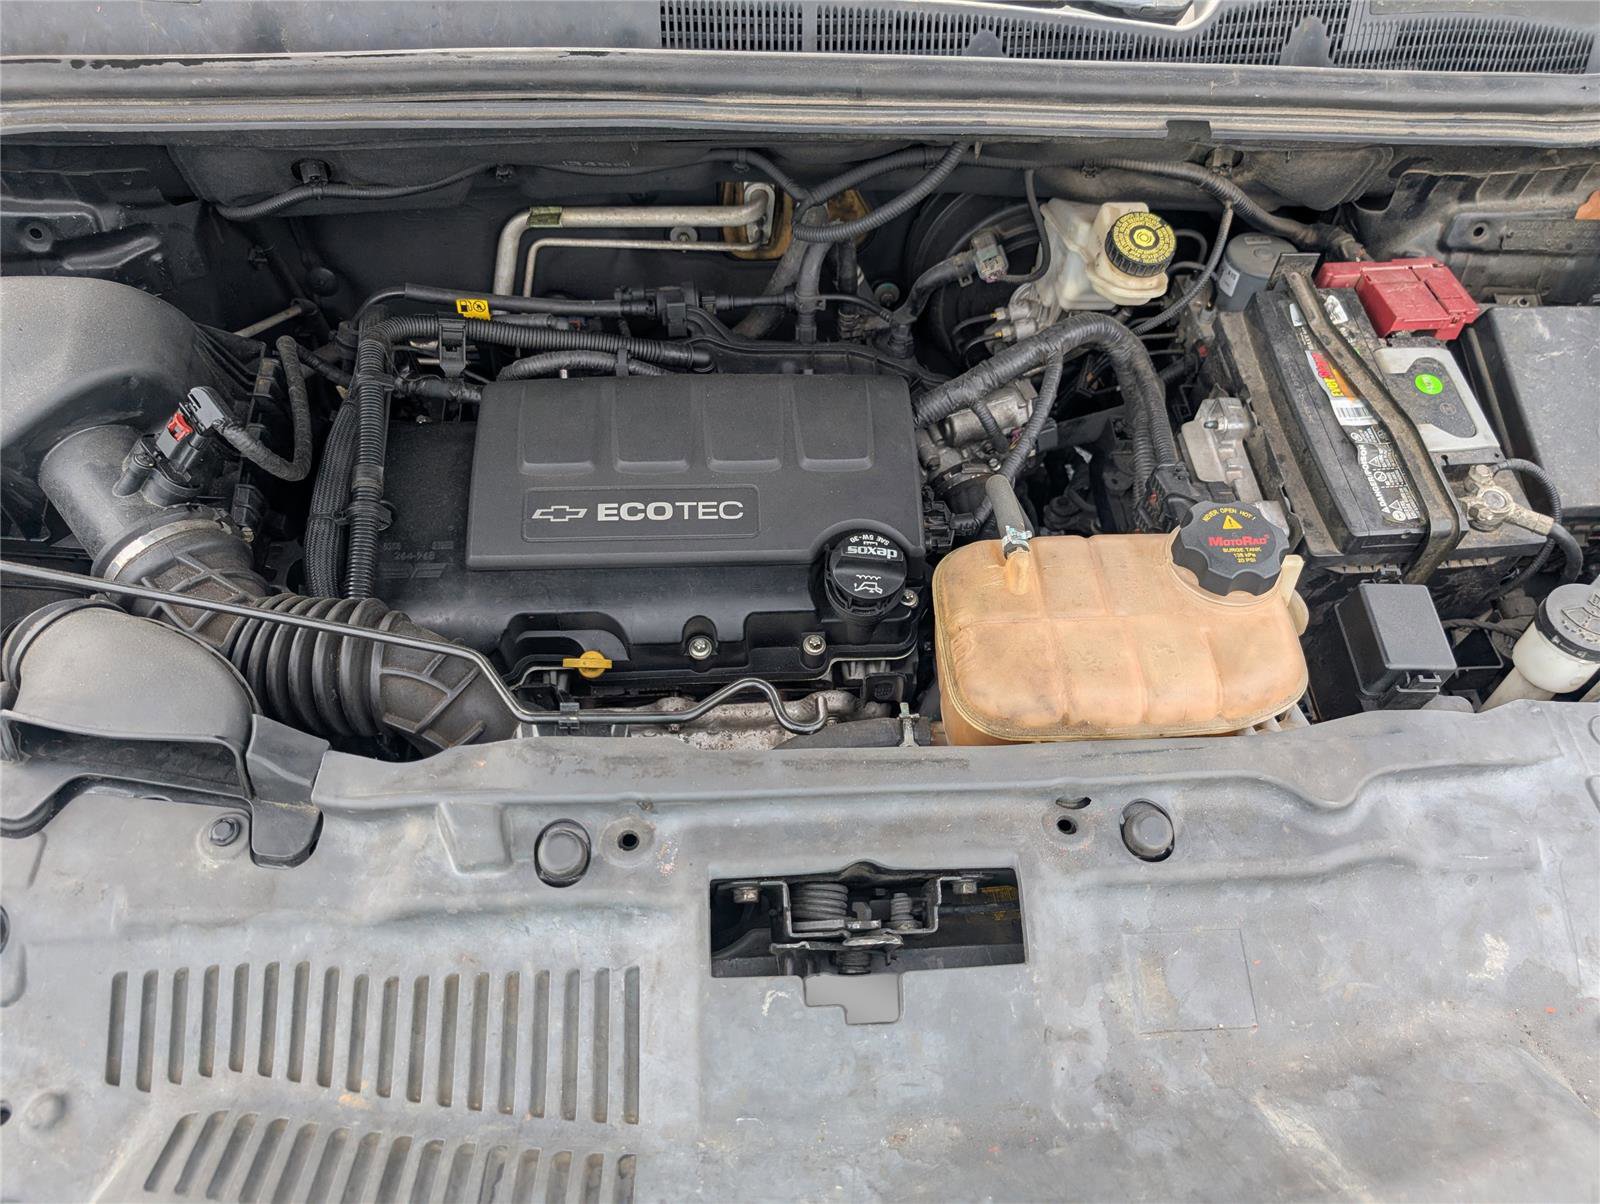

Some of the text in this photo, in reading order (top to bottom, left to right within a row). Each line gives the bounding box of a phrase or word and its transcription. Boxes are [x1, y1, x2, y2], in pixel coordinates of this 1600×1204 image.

[1357, 443, 1387, 508] DANGER/POISON
[597, 501, 743, 522] ECOTEC
[849, 534, 874, 543] 5W-30
[876, 535, 890, 546] SAE
[847, 546, 898, 559] dexos
